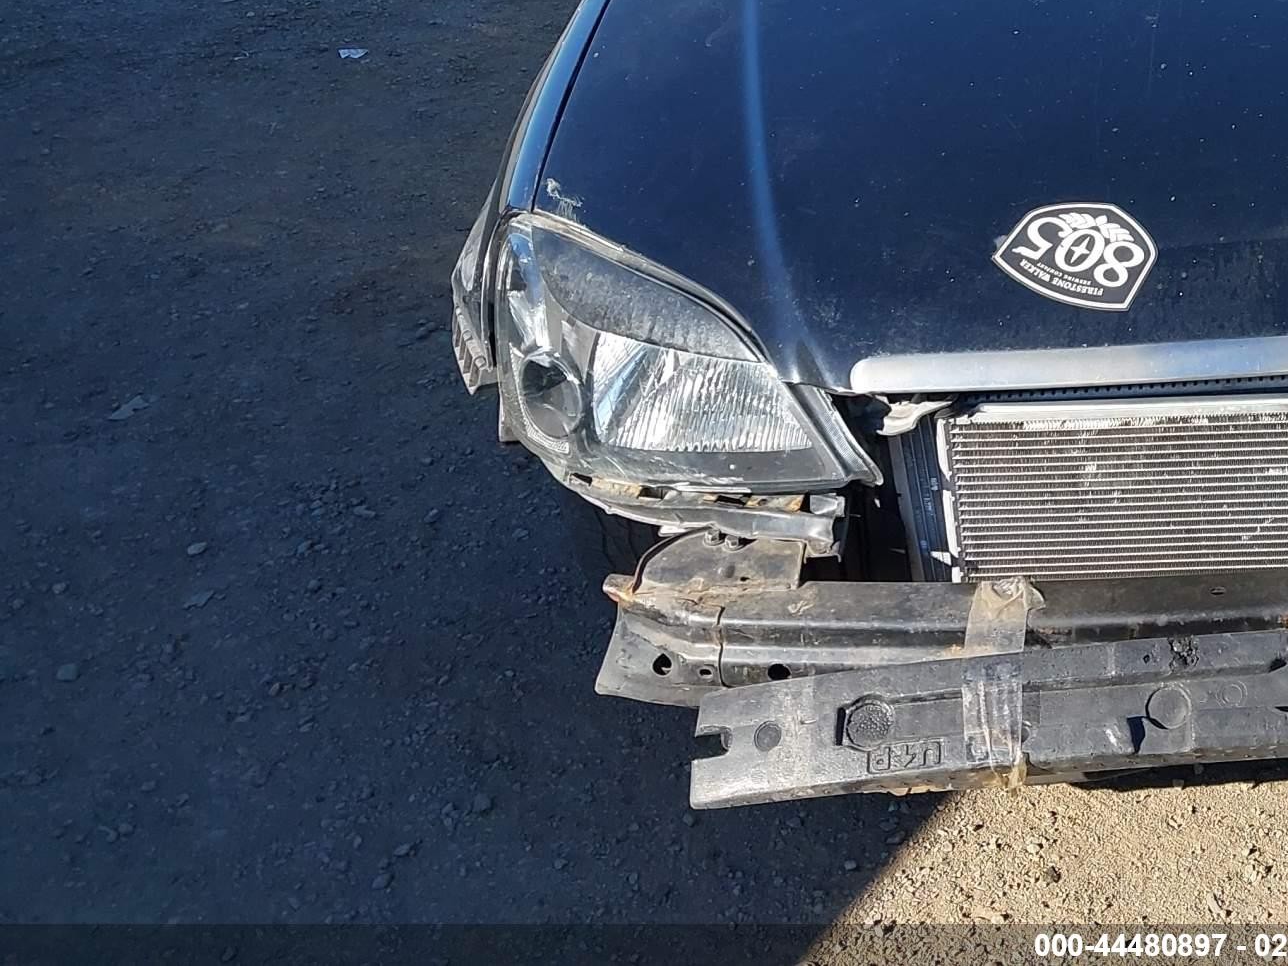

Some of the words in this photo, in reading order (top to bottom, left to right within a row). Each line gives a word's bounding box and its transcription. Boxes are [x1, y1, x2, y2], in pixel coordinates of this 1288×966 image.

[1011, 216, 1145, 288] 805
[1019, 258, 1051, 283] WALKER
[1036, 262, 1063, 277] COMPANY
[1050, 276, 1104, 296] FIRESTONE
